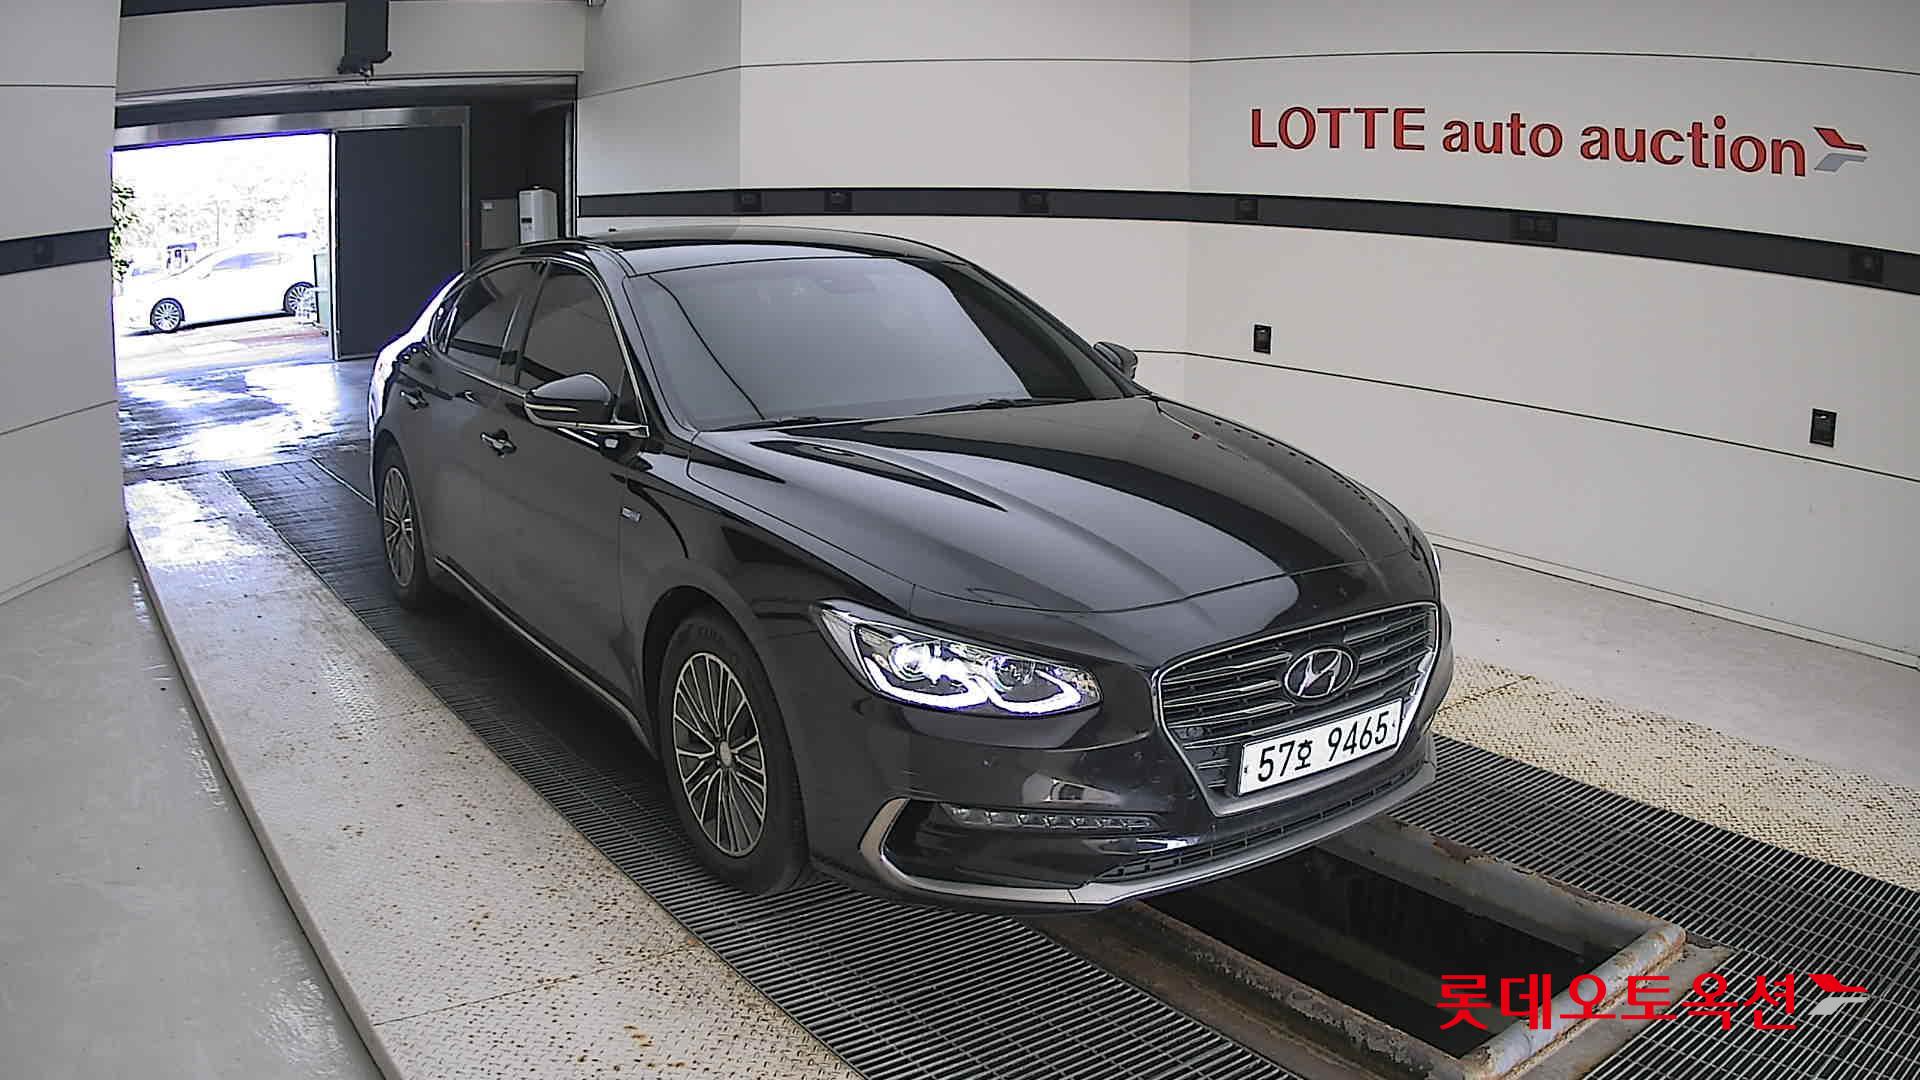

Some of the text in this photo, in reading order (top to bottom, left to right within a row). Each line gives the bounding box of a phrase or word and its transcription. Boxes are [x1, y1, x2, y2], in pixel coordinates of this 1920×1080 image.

[1251, 107, 1806, 177] LOTTE auto auction
[1258, 711, 1390, 782] 57호 9465
